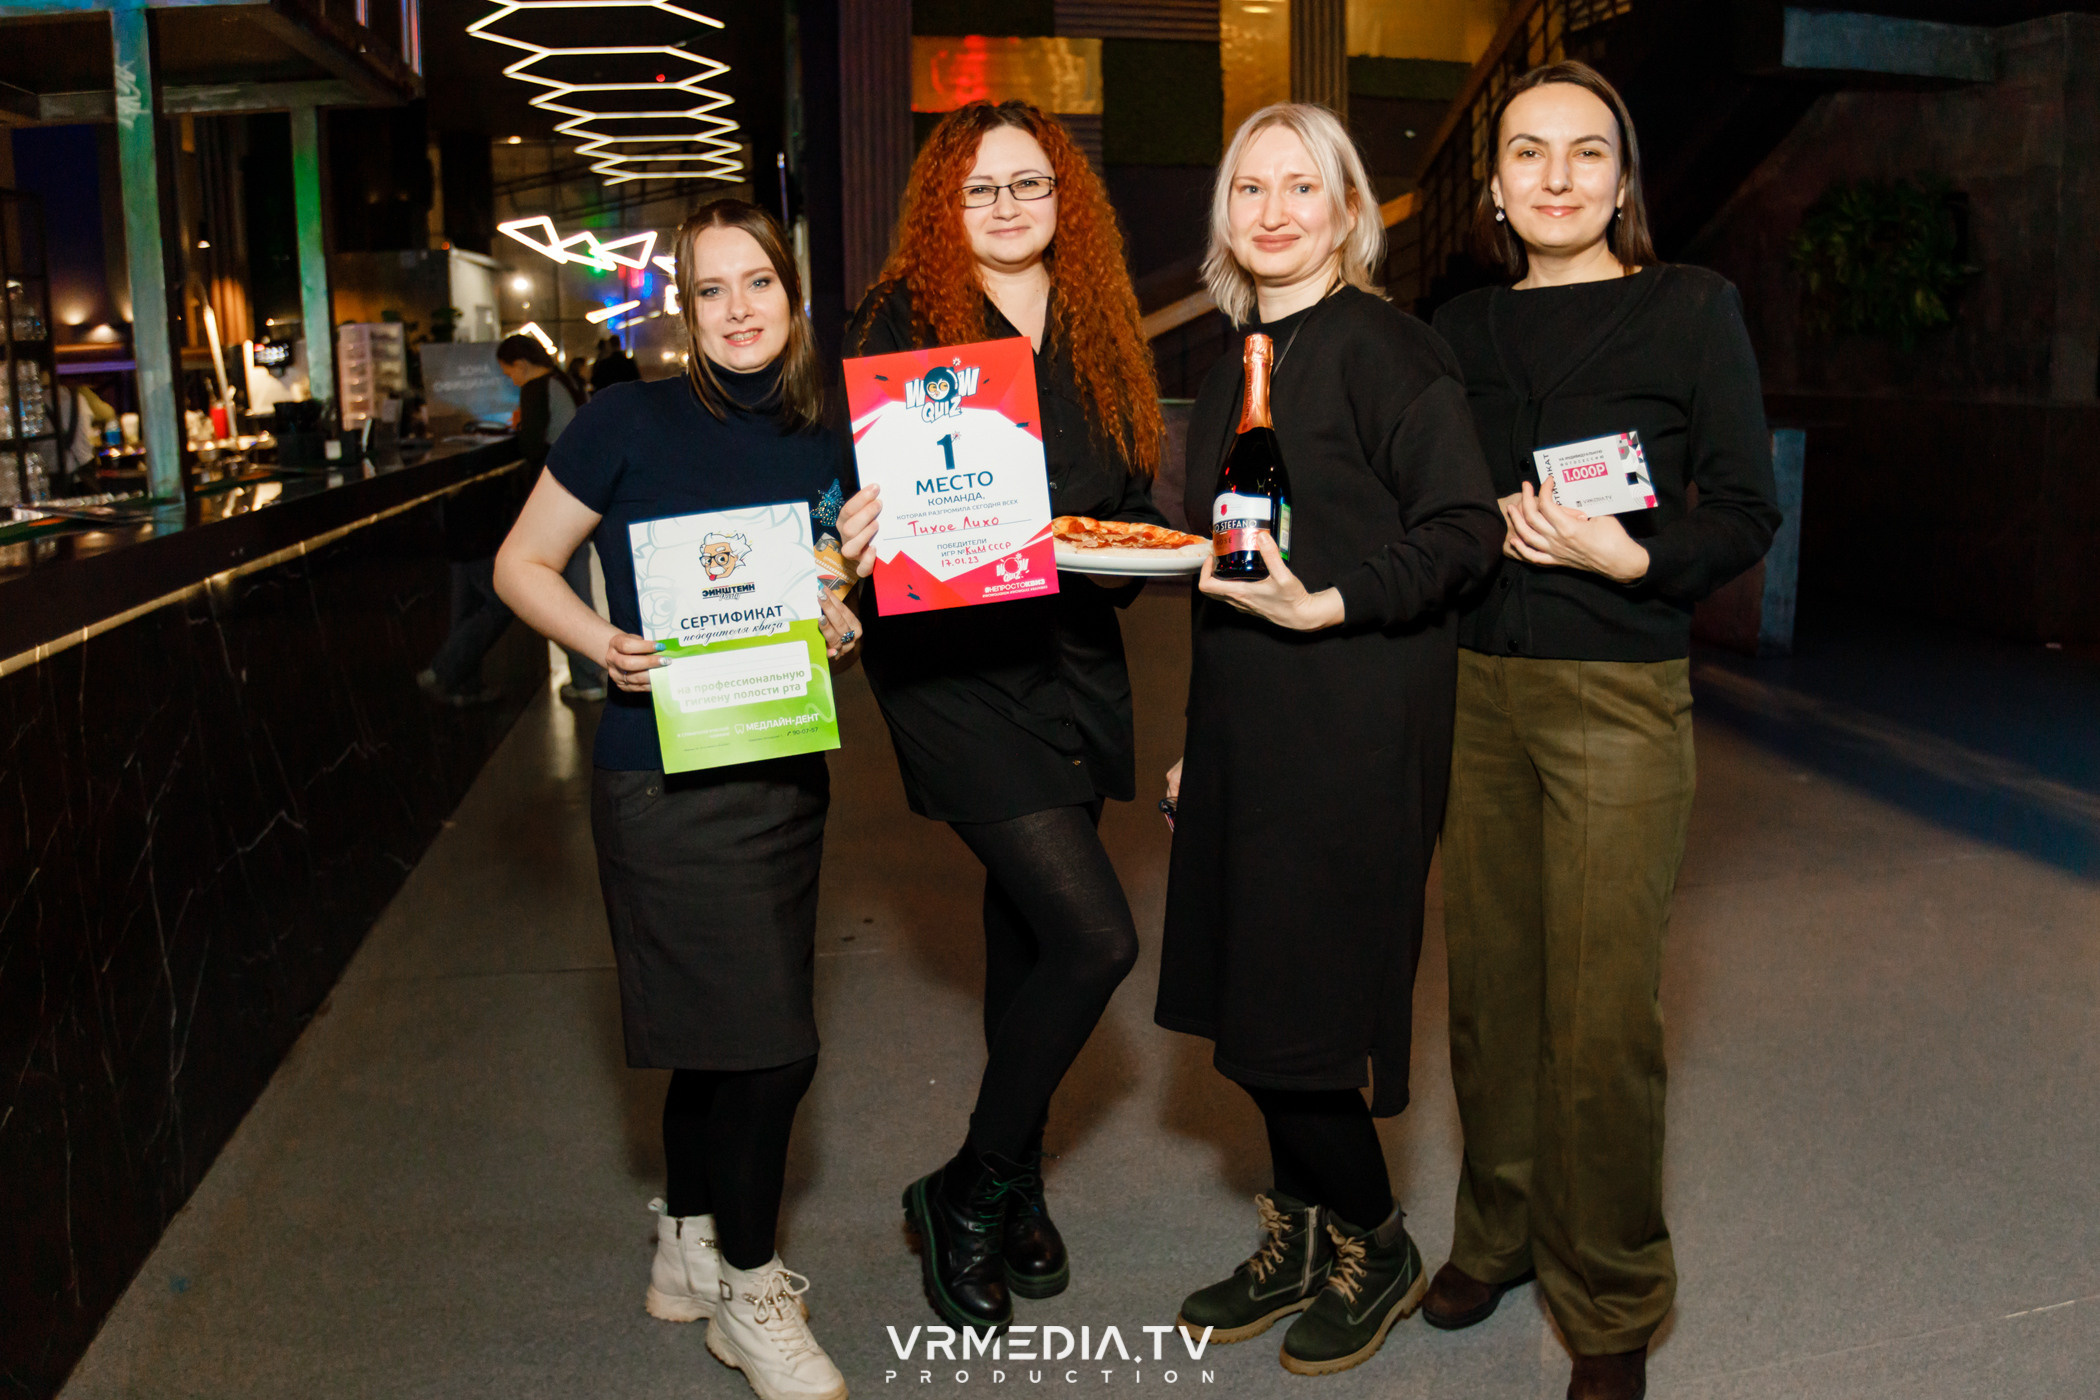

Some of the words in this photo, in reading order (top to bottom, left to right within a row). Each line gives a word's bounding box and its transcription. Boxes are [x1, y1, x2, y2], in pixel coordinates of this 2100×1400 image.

[905, 366, 980, 410] WOW
[921, 395, 963, 423] QUIZ
[936, 433, 956, 471] 1
[916, 470, 994, 495] МЕСТО
[1564, 463, 1606, 482] 1.000Р
[896, 511, 928, 521] КОТОРАЯ
[928, 505, 971, 516] РАЗГРОМИЛА
[971, 501, 1001, 511] СЕГОДНЯ
[1002, 498, 1019, 506] ВСЕХ
[907, 520, 957, 536] Тихое
[1220, 520, 1257, 530] STEFANO
[936, 538, 987, 550] ПОБЕДИТЕЛИ
[941, 549, 956, 557] ИГР
[988, 541, 1012, 552] СССР
[941, 555, 979, 568] 17.01.23
[680, 604, 784, 630] СЕРТИФИКАТ
[683, 626, 750, 644] победителя
[752, 618, 783, 635] квиза
[694, 670, 805, 693] профессиональную
[685, 693, 731, 707] гигиену
[734, 685, 780, 700] полости
[782, 682, 801, 694] рта
[745, 712, 820, 732] МЕДЛАЙН-ДЕНТ
